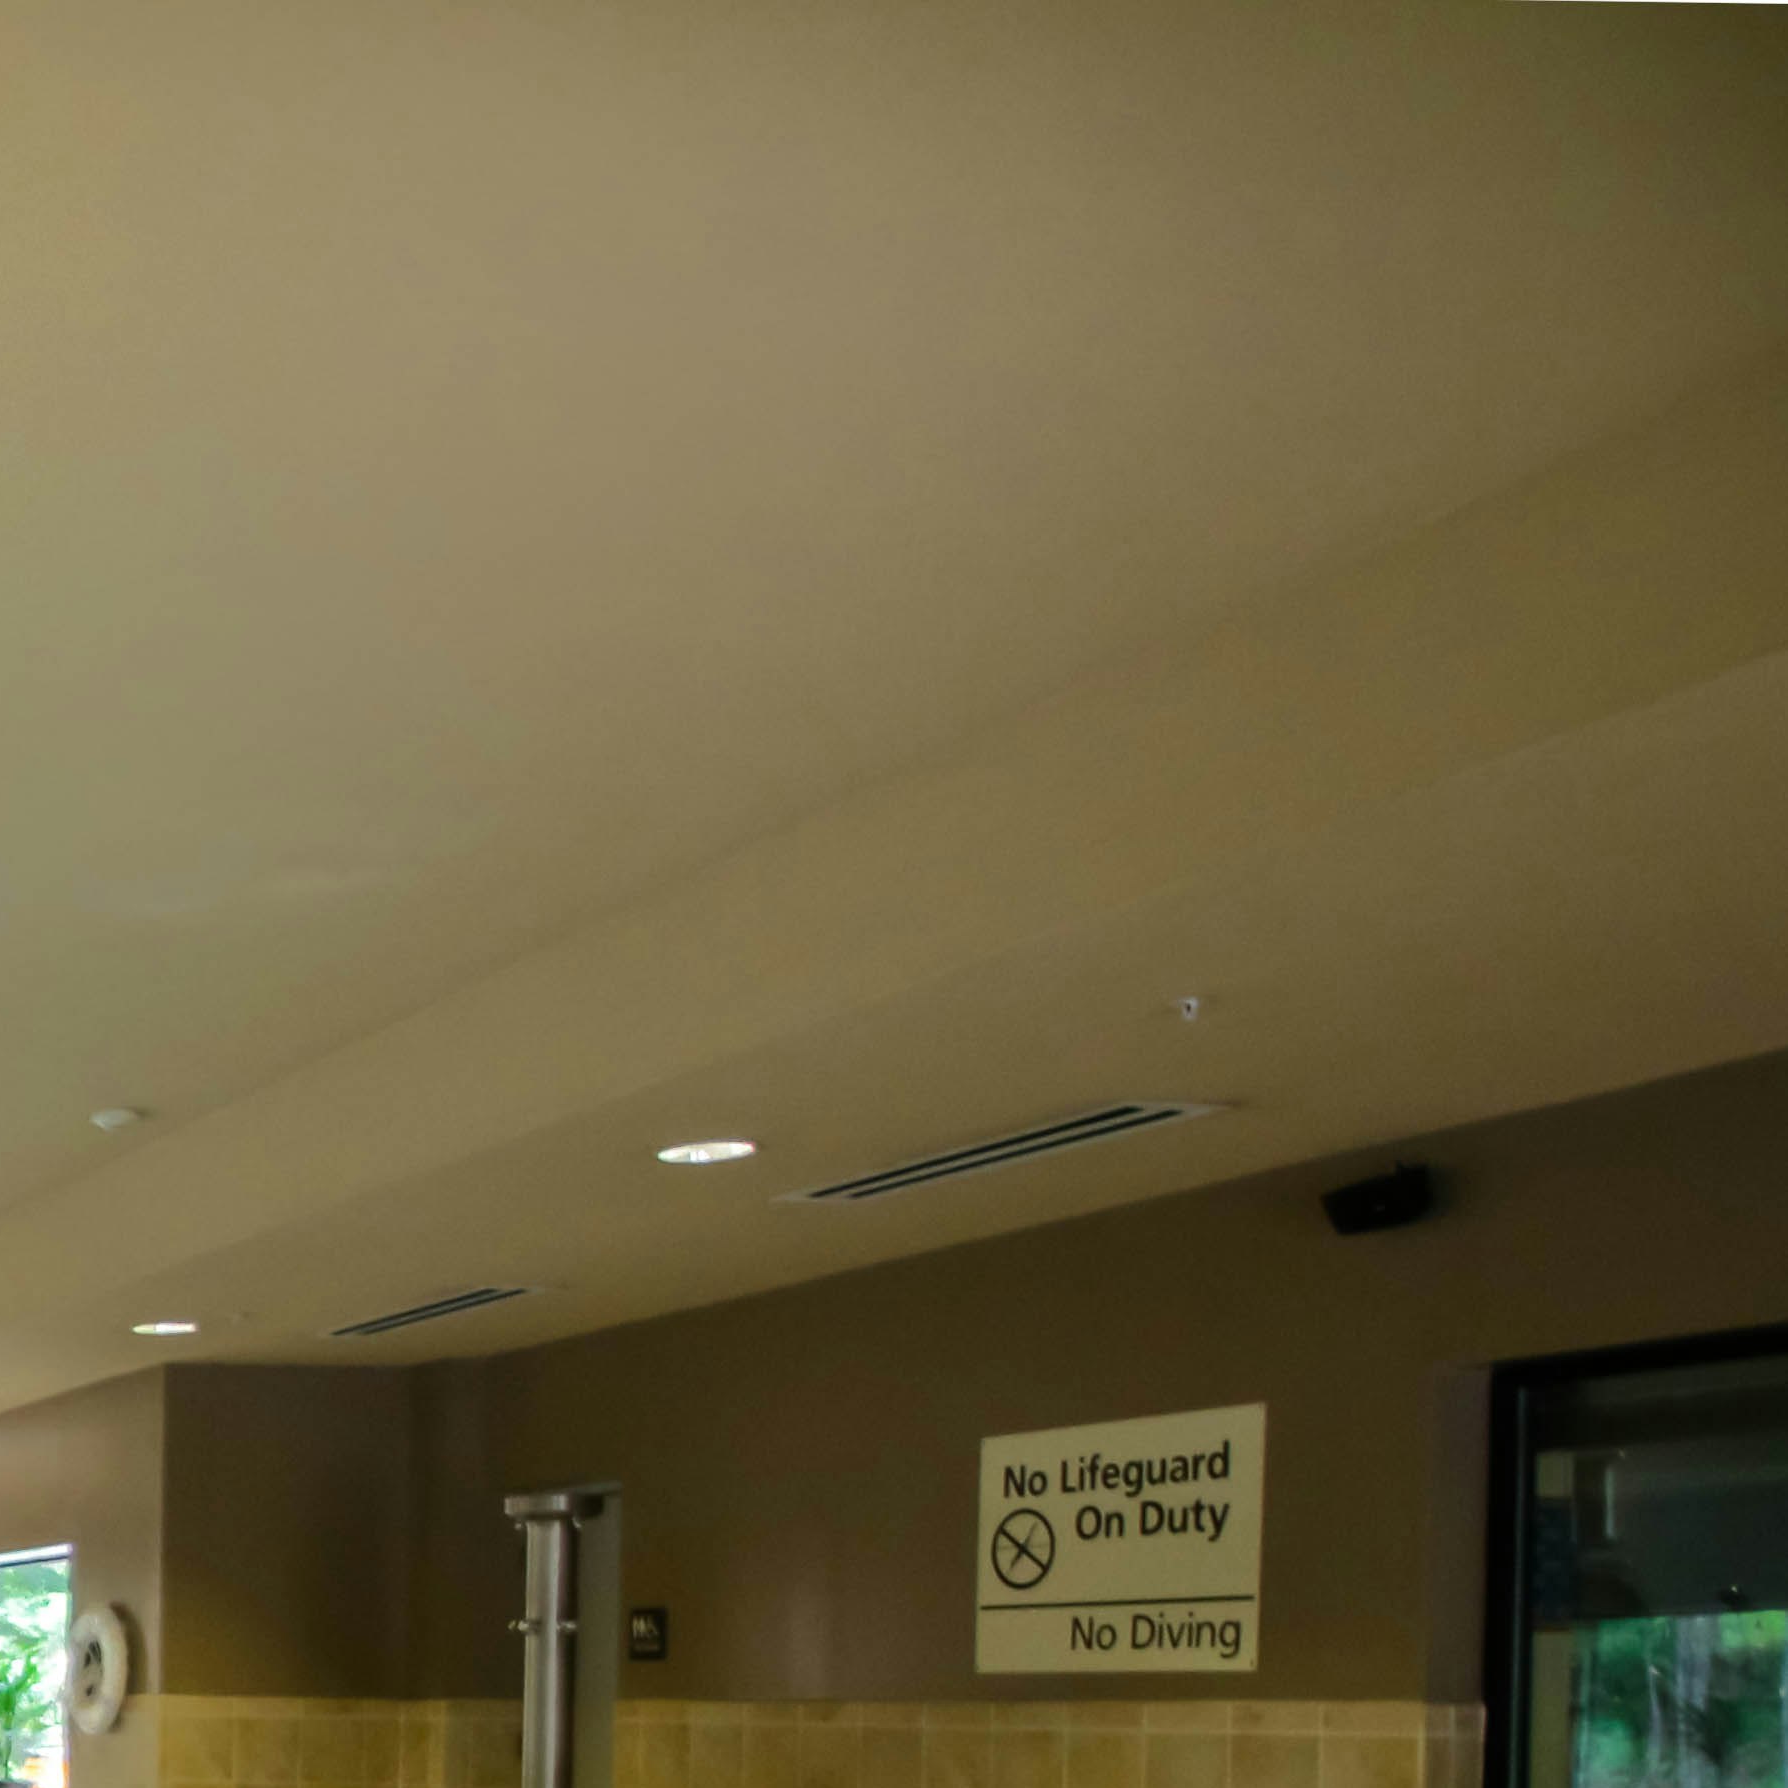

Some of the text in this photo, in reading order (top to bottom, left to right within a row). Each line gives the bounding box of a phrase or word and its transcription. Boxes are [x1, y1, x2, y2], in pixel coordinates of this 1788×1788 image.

[1003, 1439, 1231, 1499] No Lifeguard
[1075, 1499, 1231, 1542] On Duty
[1070, 1611, 1242, 1658] No Diving
